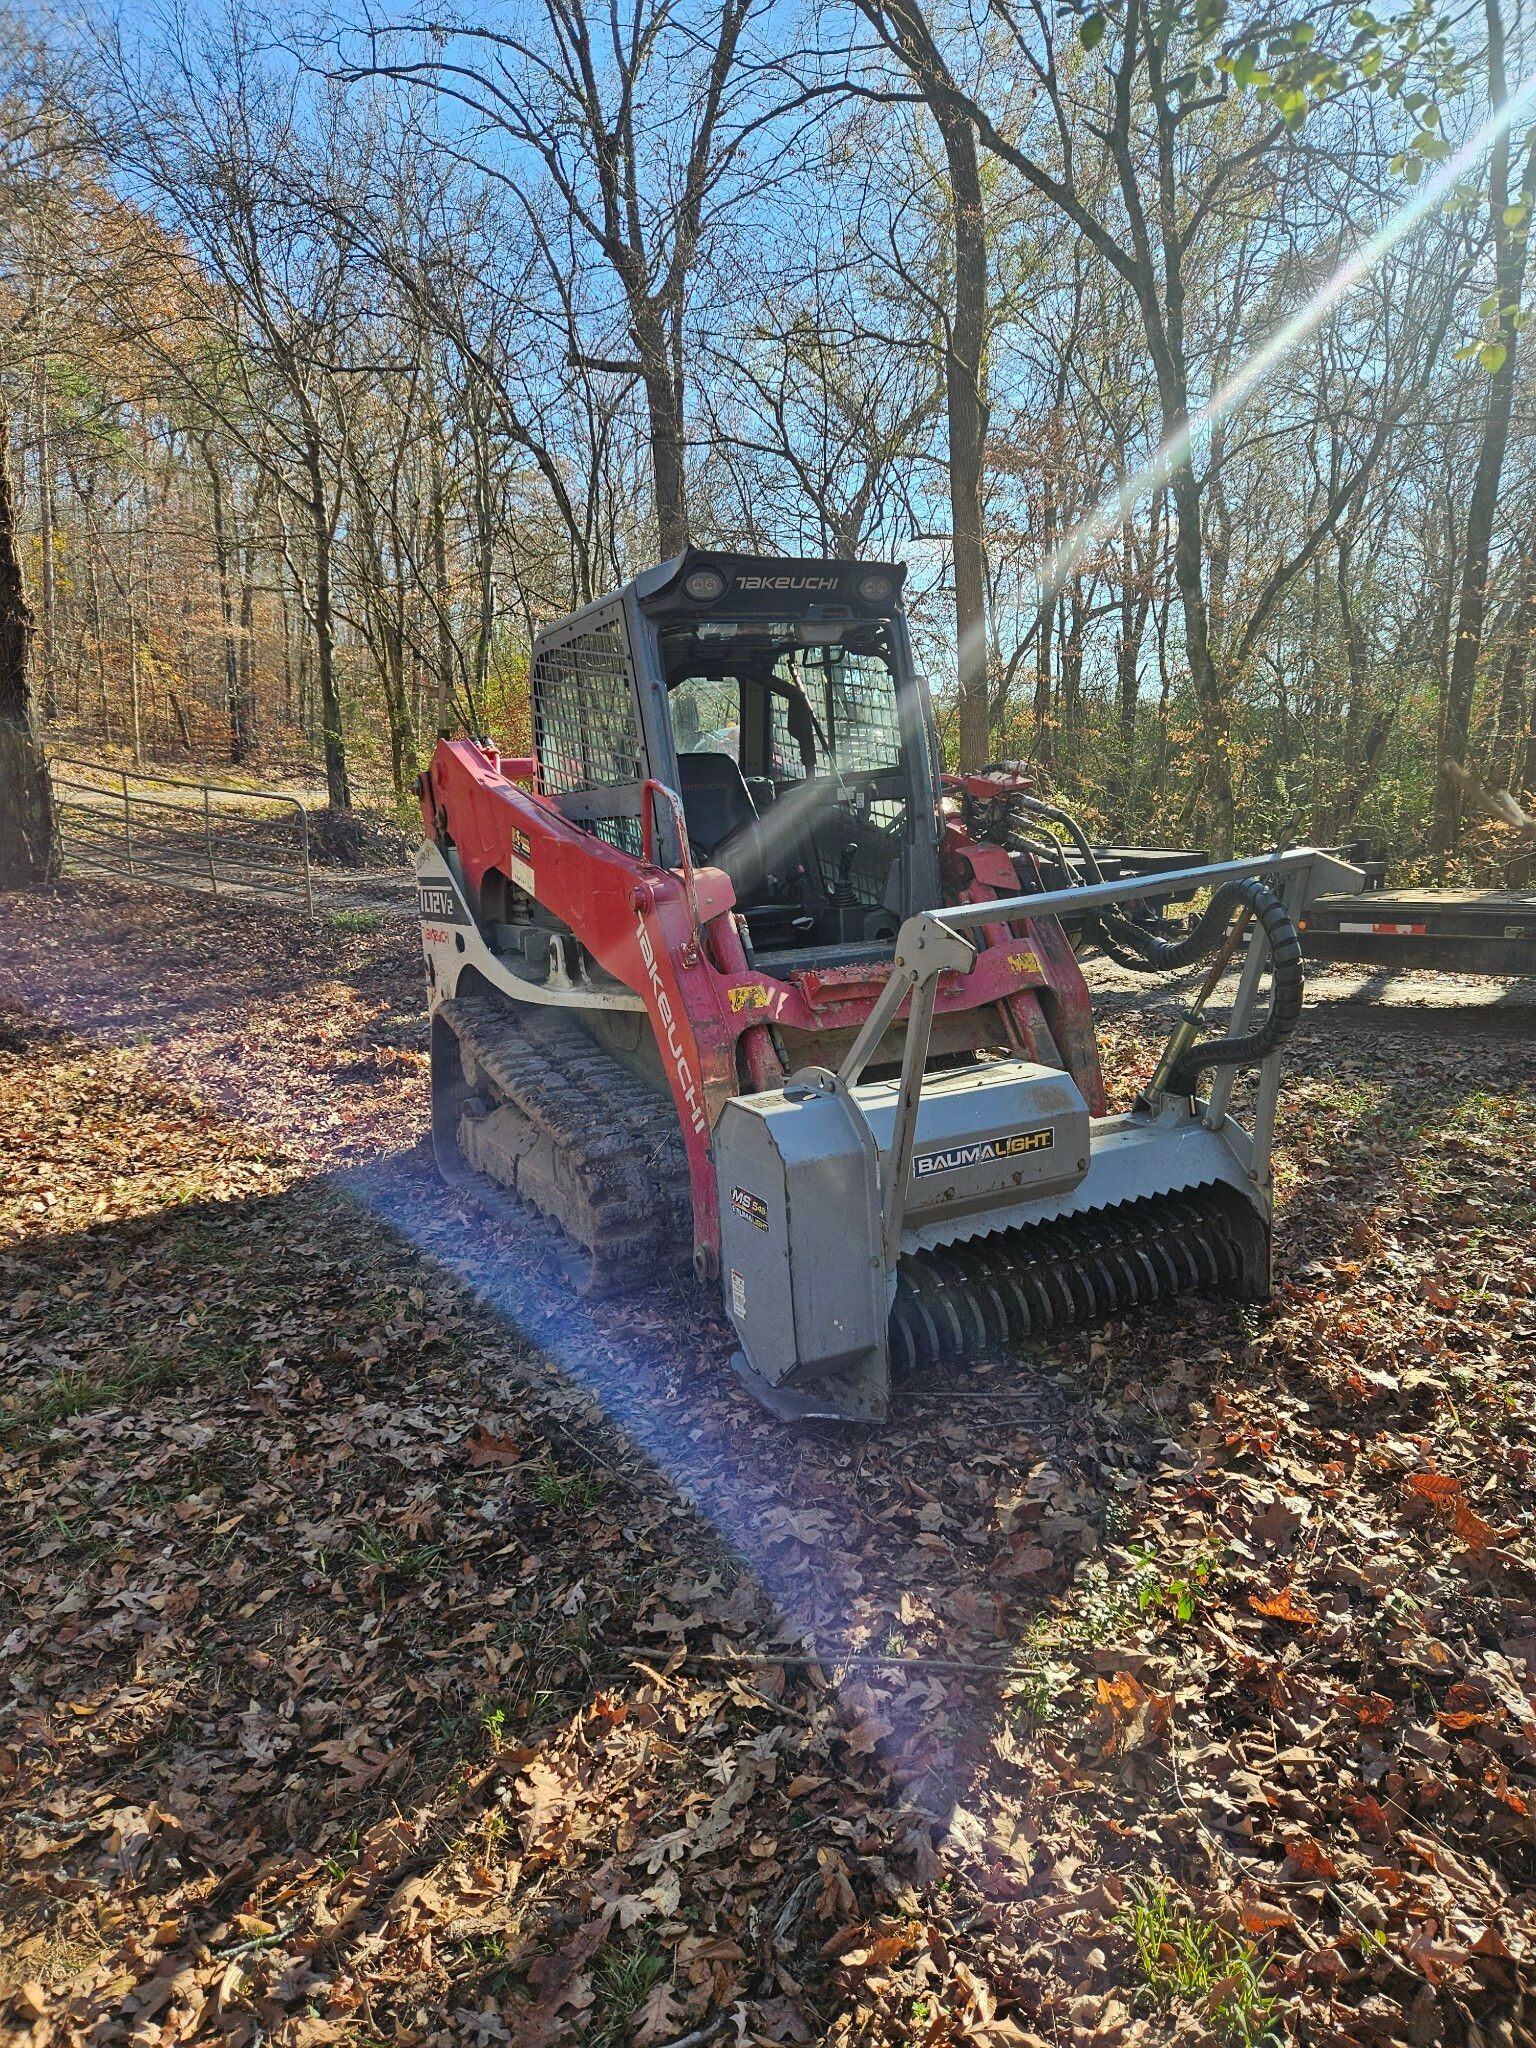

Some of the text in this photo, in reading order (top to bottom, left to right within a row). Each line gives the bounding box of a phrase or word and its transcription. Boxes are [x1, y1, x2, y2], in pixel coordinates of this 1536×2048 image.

[736, 576, 839, 590] TAKEUCHI
[637, 909, 706, 1135] TAKEUCHI
[917, 1131, 1051, 1174] BAUMALIGHT
[732, 1189, 751, 1208] MS
